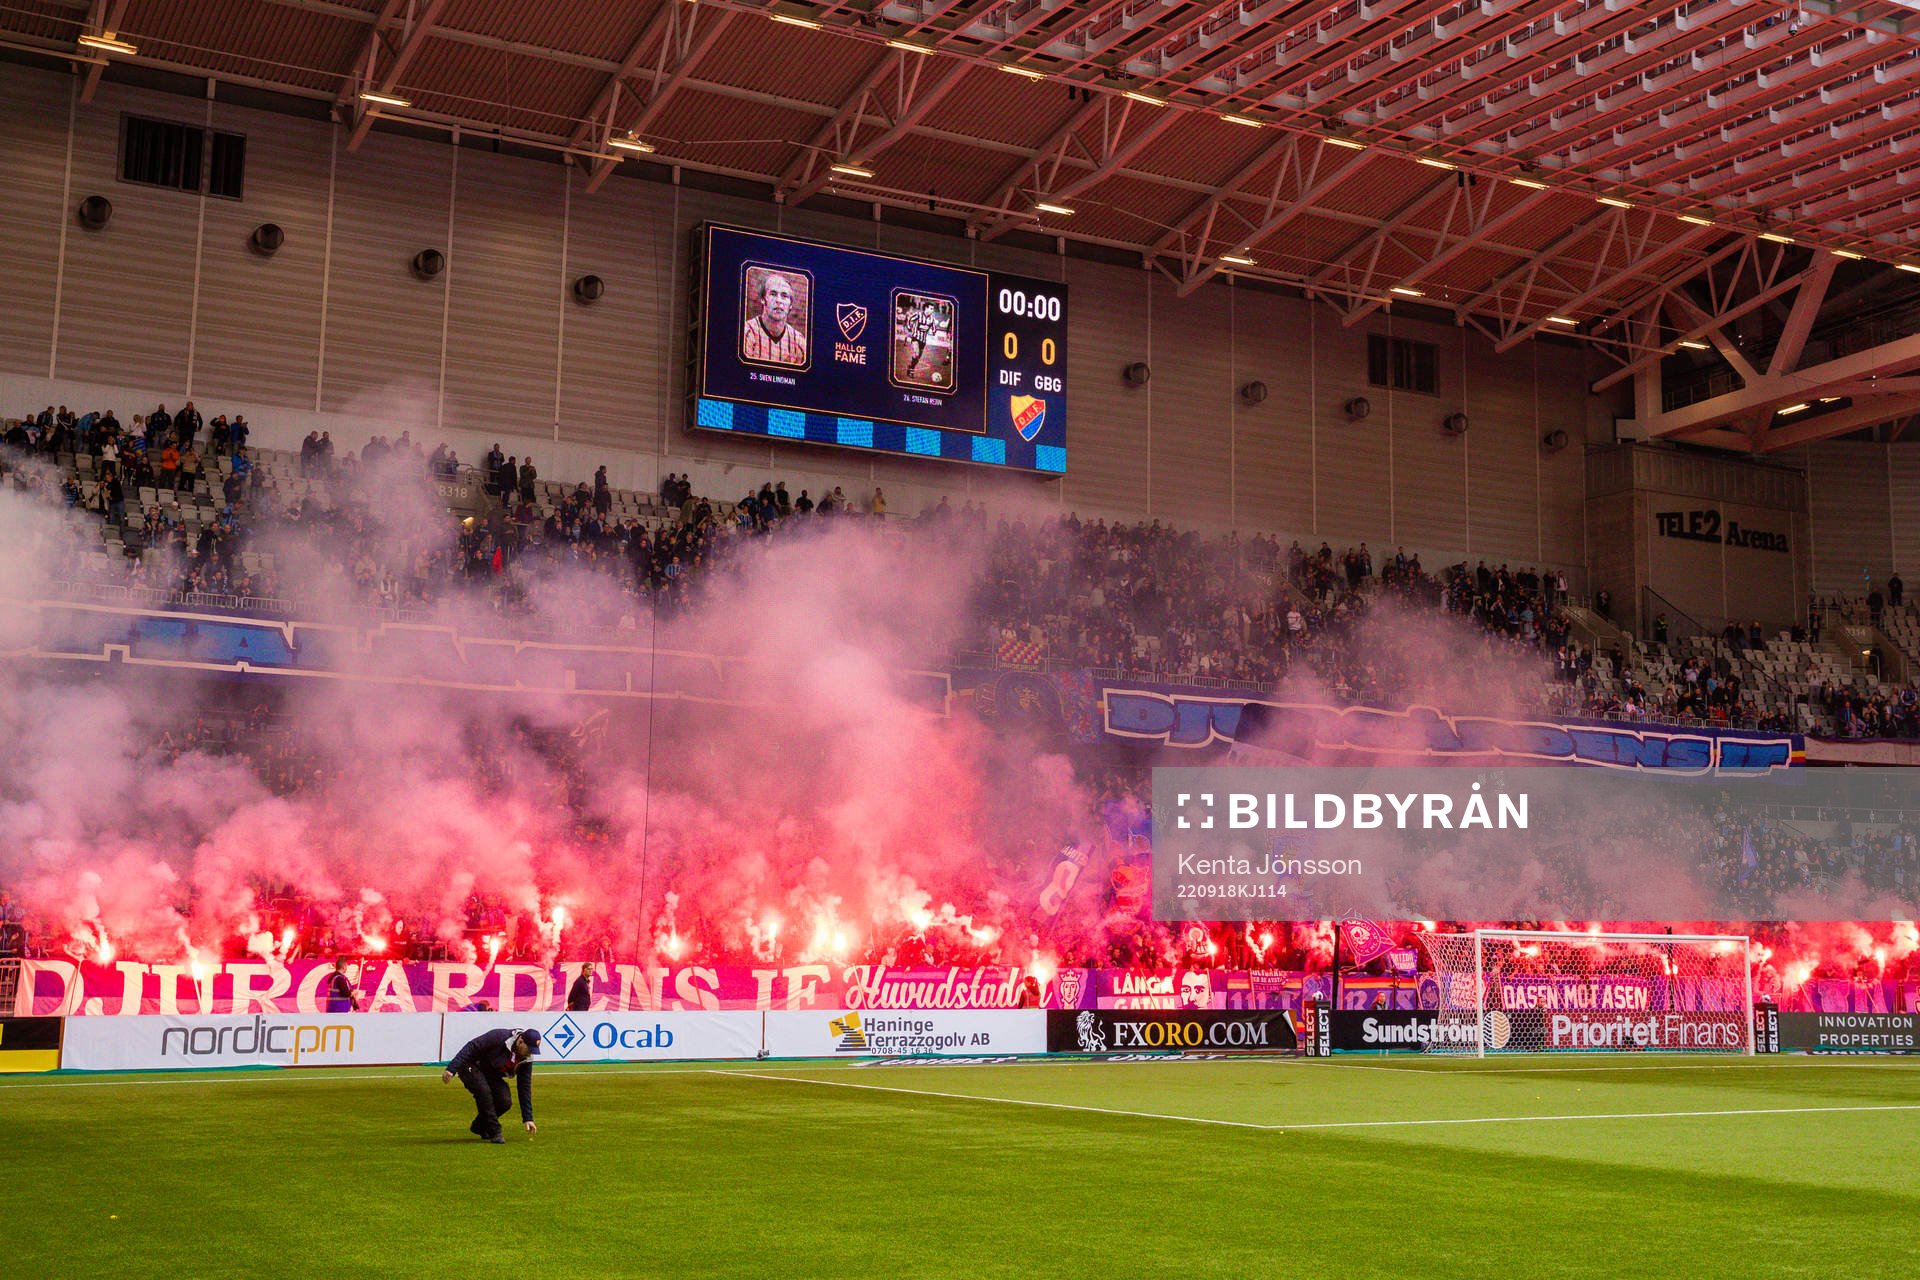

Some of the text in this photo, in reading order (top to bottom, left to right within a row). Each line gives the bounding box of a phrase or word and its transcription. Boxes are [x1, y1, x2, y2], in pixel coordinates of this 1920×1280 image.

[999, 289, 1061, 321] 00:00
[834, 352, 867, 365] FAME
[835, 342, 867, 354] HALL OF
[1004, 332, 1056, 365] 0 0
[1000, 370, 1062, 392] DIF GBG
[1656, 510, 1790, 552] TELE2 Arena
[752, 965, 831, 1011] IF
[1113, 972, 1175, 994] LÅNGA
[593, 1022, 673, 1048] Ocab
[864, 1017, 934, 1035] Haninge
[1113, 1021, 1268, 1047] FXORO.COM
[1305, 1008, 1315, 1056] SELECT
[1319, 1008, 1329, 1056] SELECT
[1362, 1017, 1478, 1043] Sundström
[1552, 1015, 1739, 1046] Prioritet Finans
[1756, 1010, 1766, 1053] SELECT
[1768, 1010, 1779, 1053] SELECT
[1819, 1016, 1913, 1028] INNOVATION
[865, 1032, 990, 1050] Terrazzogolv AB
[1820, 1034, 1914, 1046] PROPERTIES
